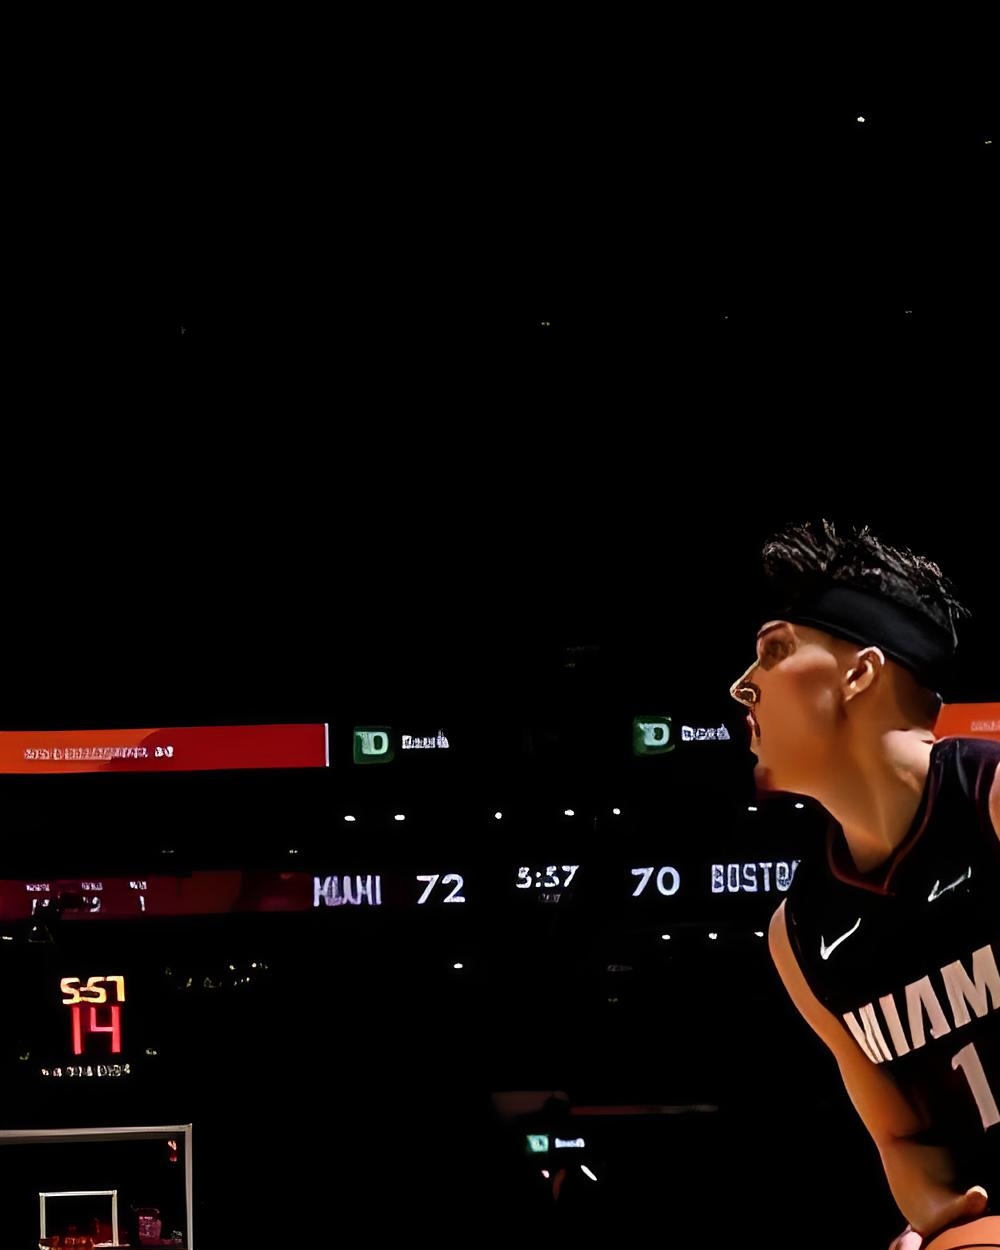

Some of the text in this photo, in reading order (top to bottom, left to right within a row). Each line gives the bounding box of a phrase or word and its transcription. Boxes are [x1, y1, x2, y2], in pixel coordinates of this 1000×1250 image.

[416, 873, 466, 905] 72
[631, 865, 681, 897] 70
[71, 1005, 122, 1056] 14
